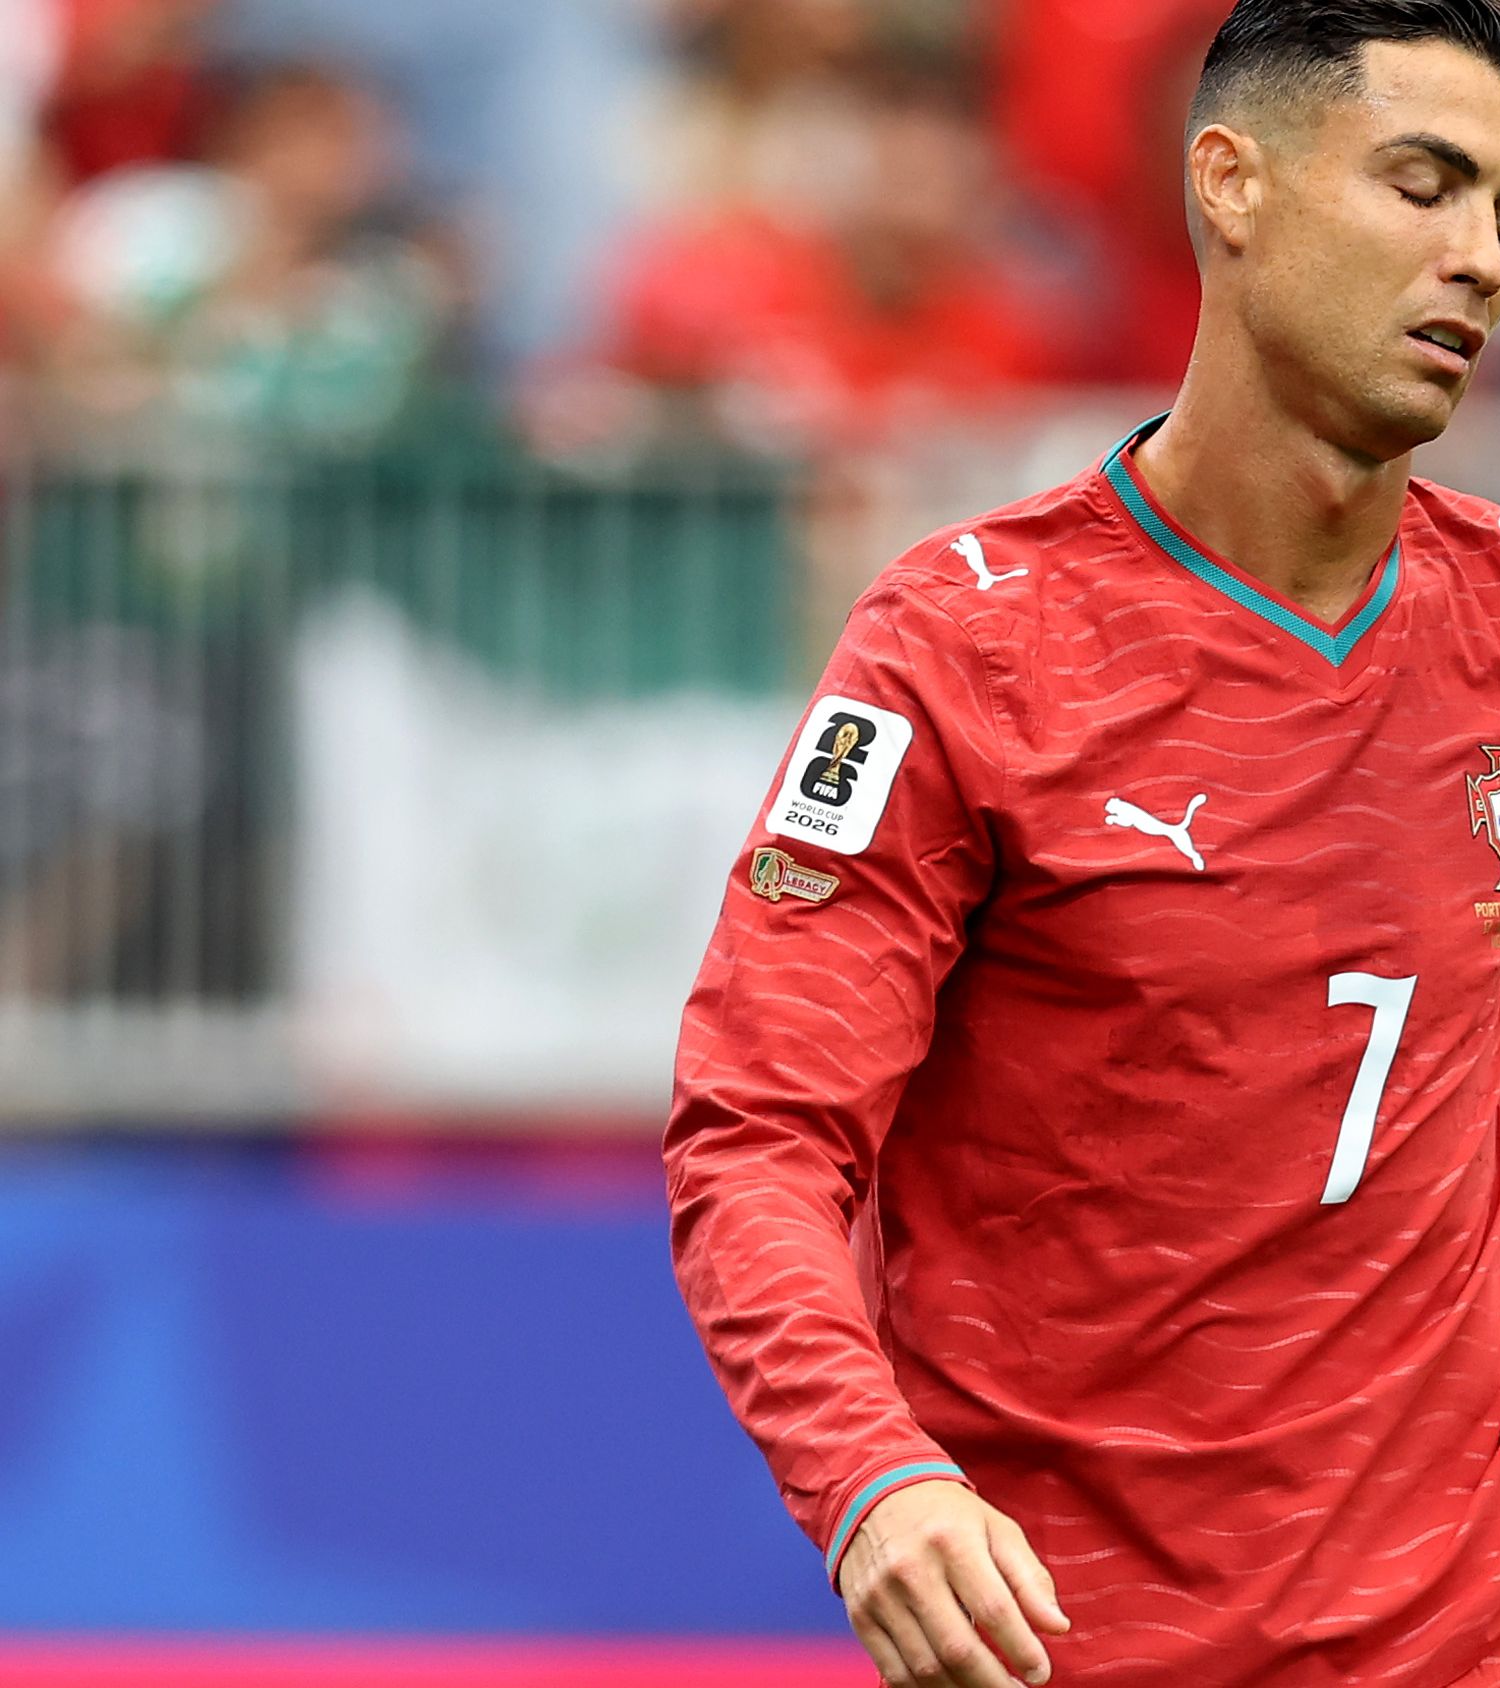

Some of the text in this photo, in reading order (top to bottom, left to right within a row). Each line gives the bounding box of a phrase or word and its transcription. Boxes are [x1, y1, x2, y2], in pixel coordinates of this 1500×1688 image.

[812, 781, 839, 800] FIFA
[791, 799, 844, 822] WORLD CUP
[785, 810, 839, 836] 2026
[786, 873, 827, 895] LEGACY
[1320, 971, 1418, 1204] 7
